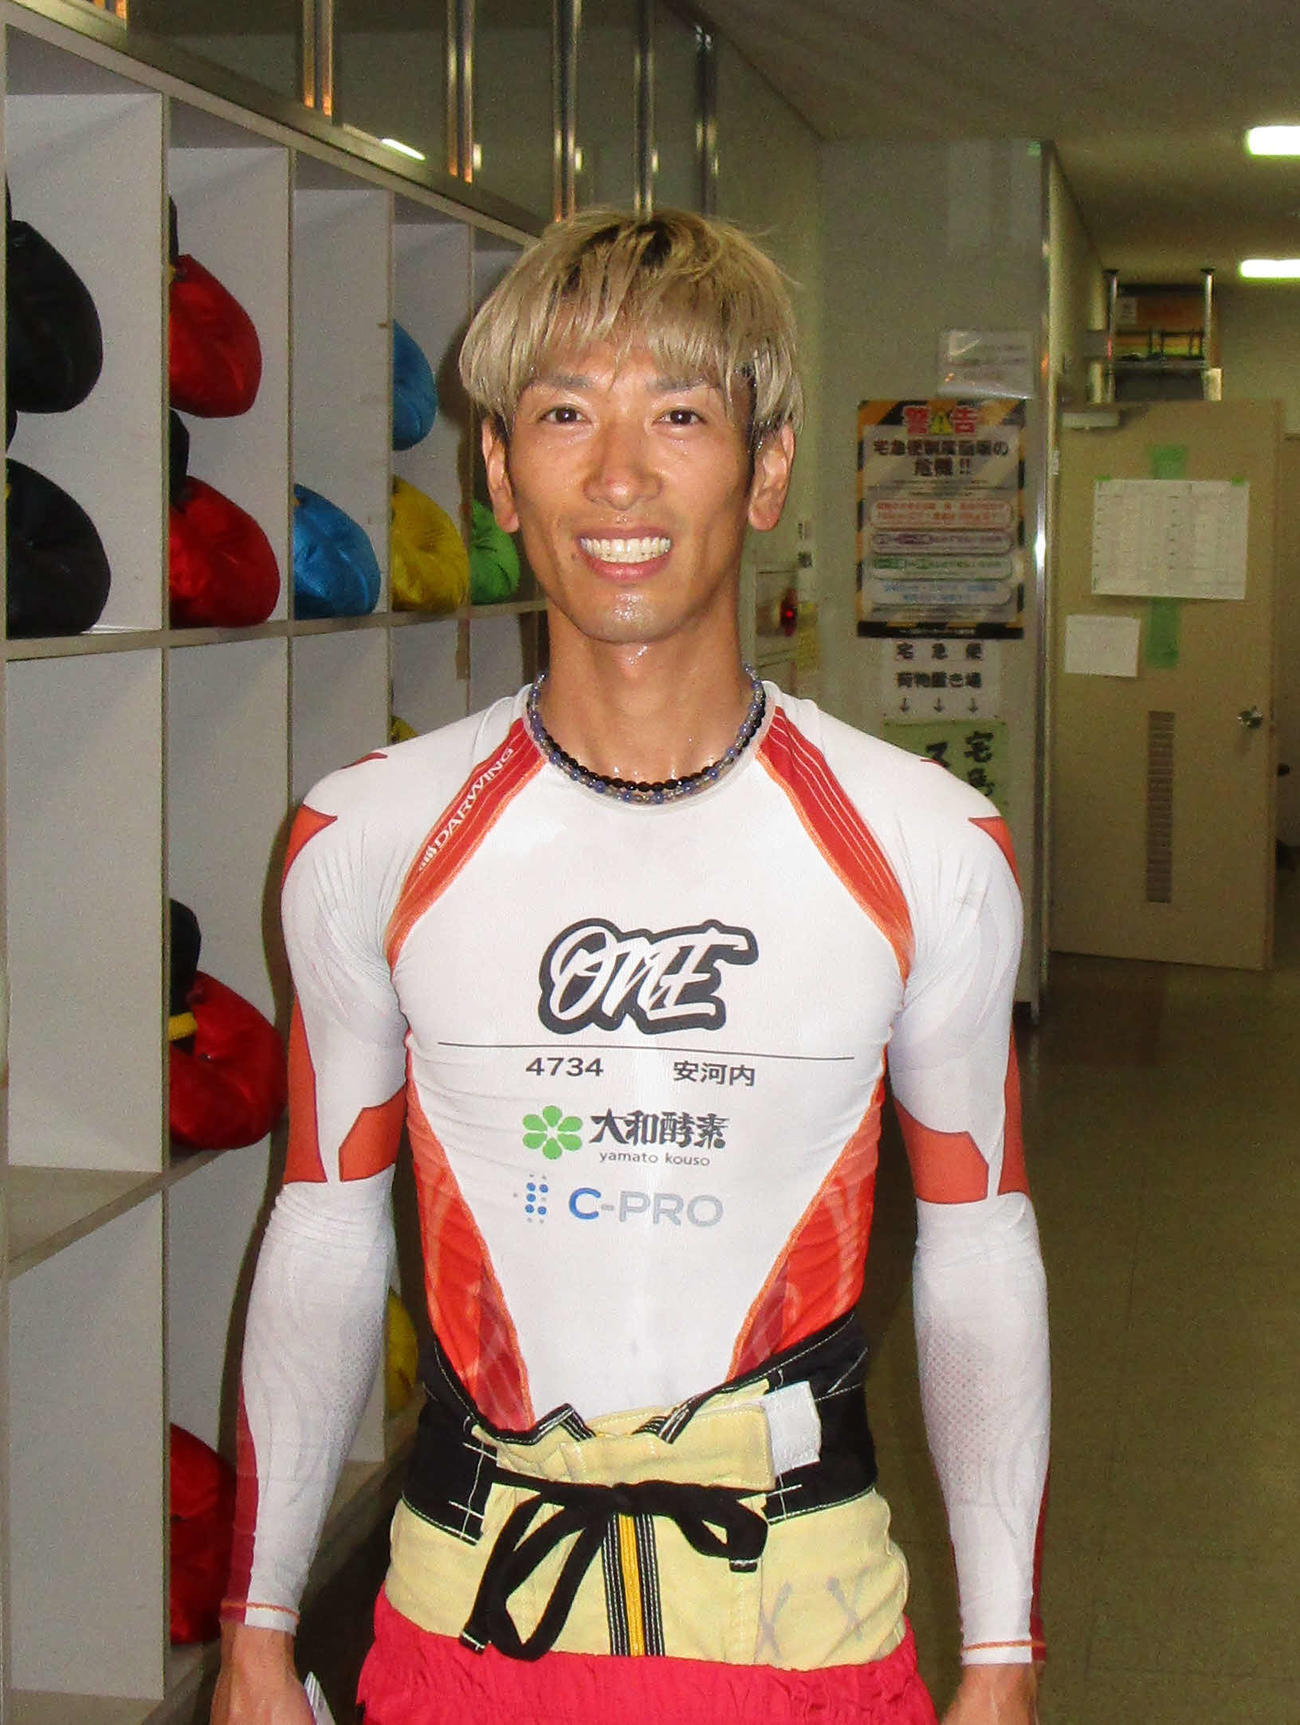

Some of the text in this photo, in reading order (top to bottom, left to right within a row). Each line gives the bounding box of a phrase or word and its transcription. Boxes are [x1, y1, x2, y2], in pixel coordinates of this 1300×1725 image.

[904, 405, 978, 435] 警告
[897, 671, 982, 688] 荷物置き場
[434, 748, 514, 849] DARWING
[538, 917, 759, 1035] ONE
[525, 1057, 756, 1087] 4734 安河内
[588, 1107, 731, 1149] 大和酵素
[599, 1151, 711, 1167] yamato kouso
[568, 1187, 724, 1228] C-PRO
